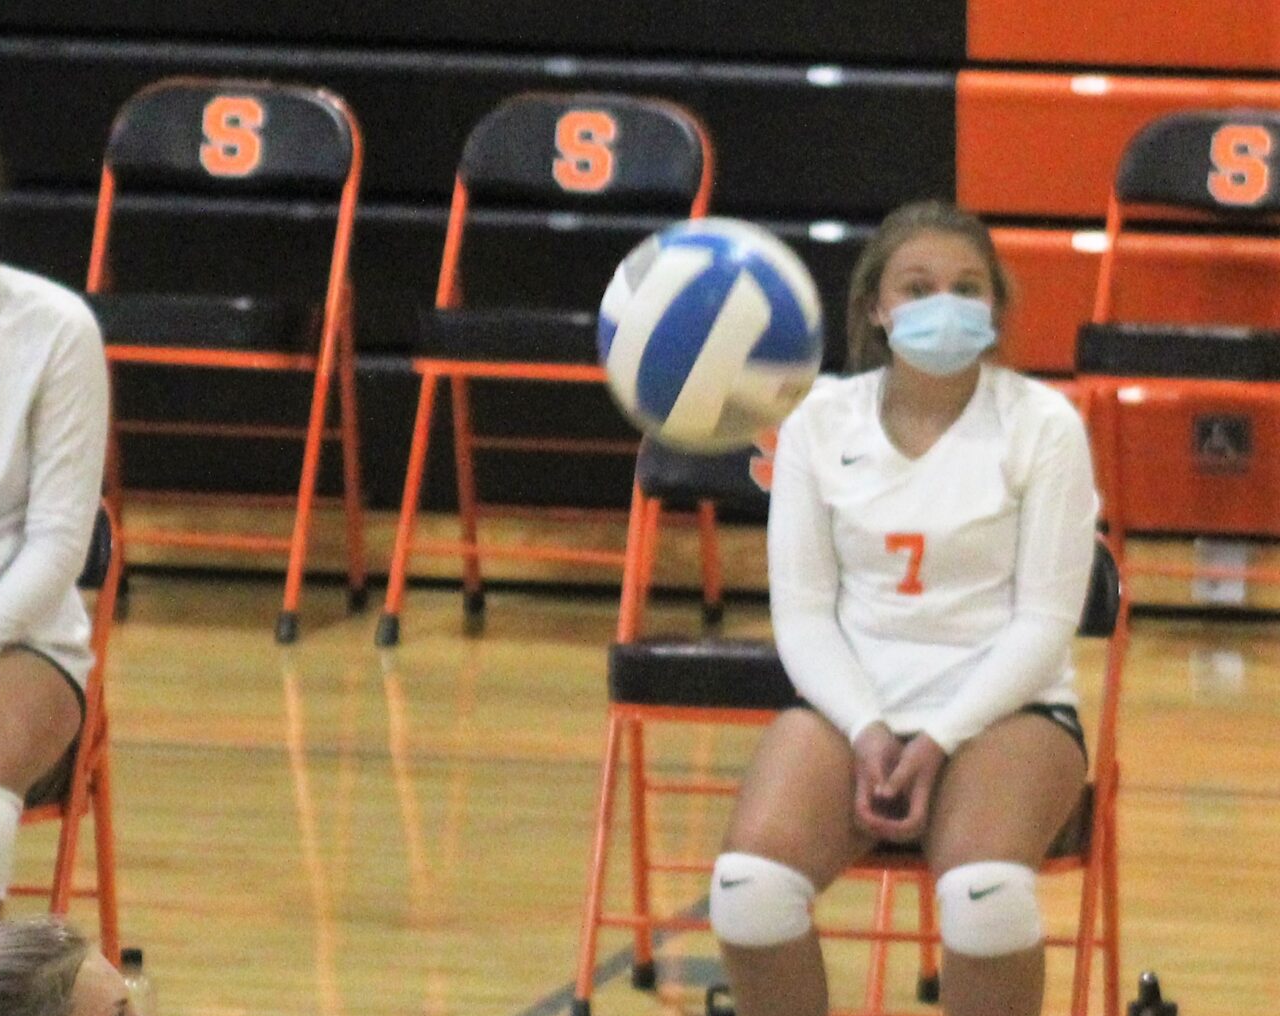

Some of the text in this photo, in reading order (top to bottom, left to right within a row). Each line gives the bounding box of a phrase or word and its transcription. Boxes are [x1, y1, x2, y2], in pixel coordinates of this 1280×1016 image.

[200, 94, 264, 177] S
[553, 109, 617, 193] S
[1208, 123, 1274, 206] S
[884, 531, 927, 597] 7
